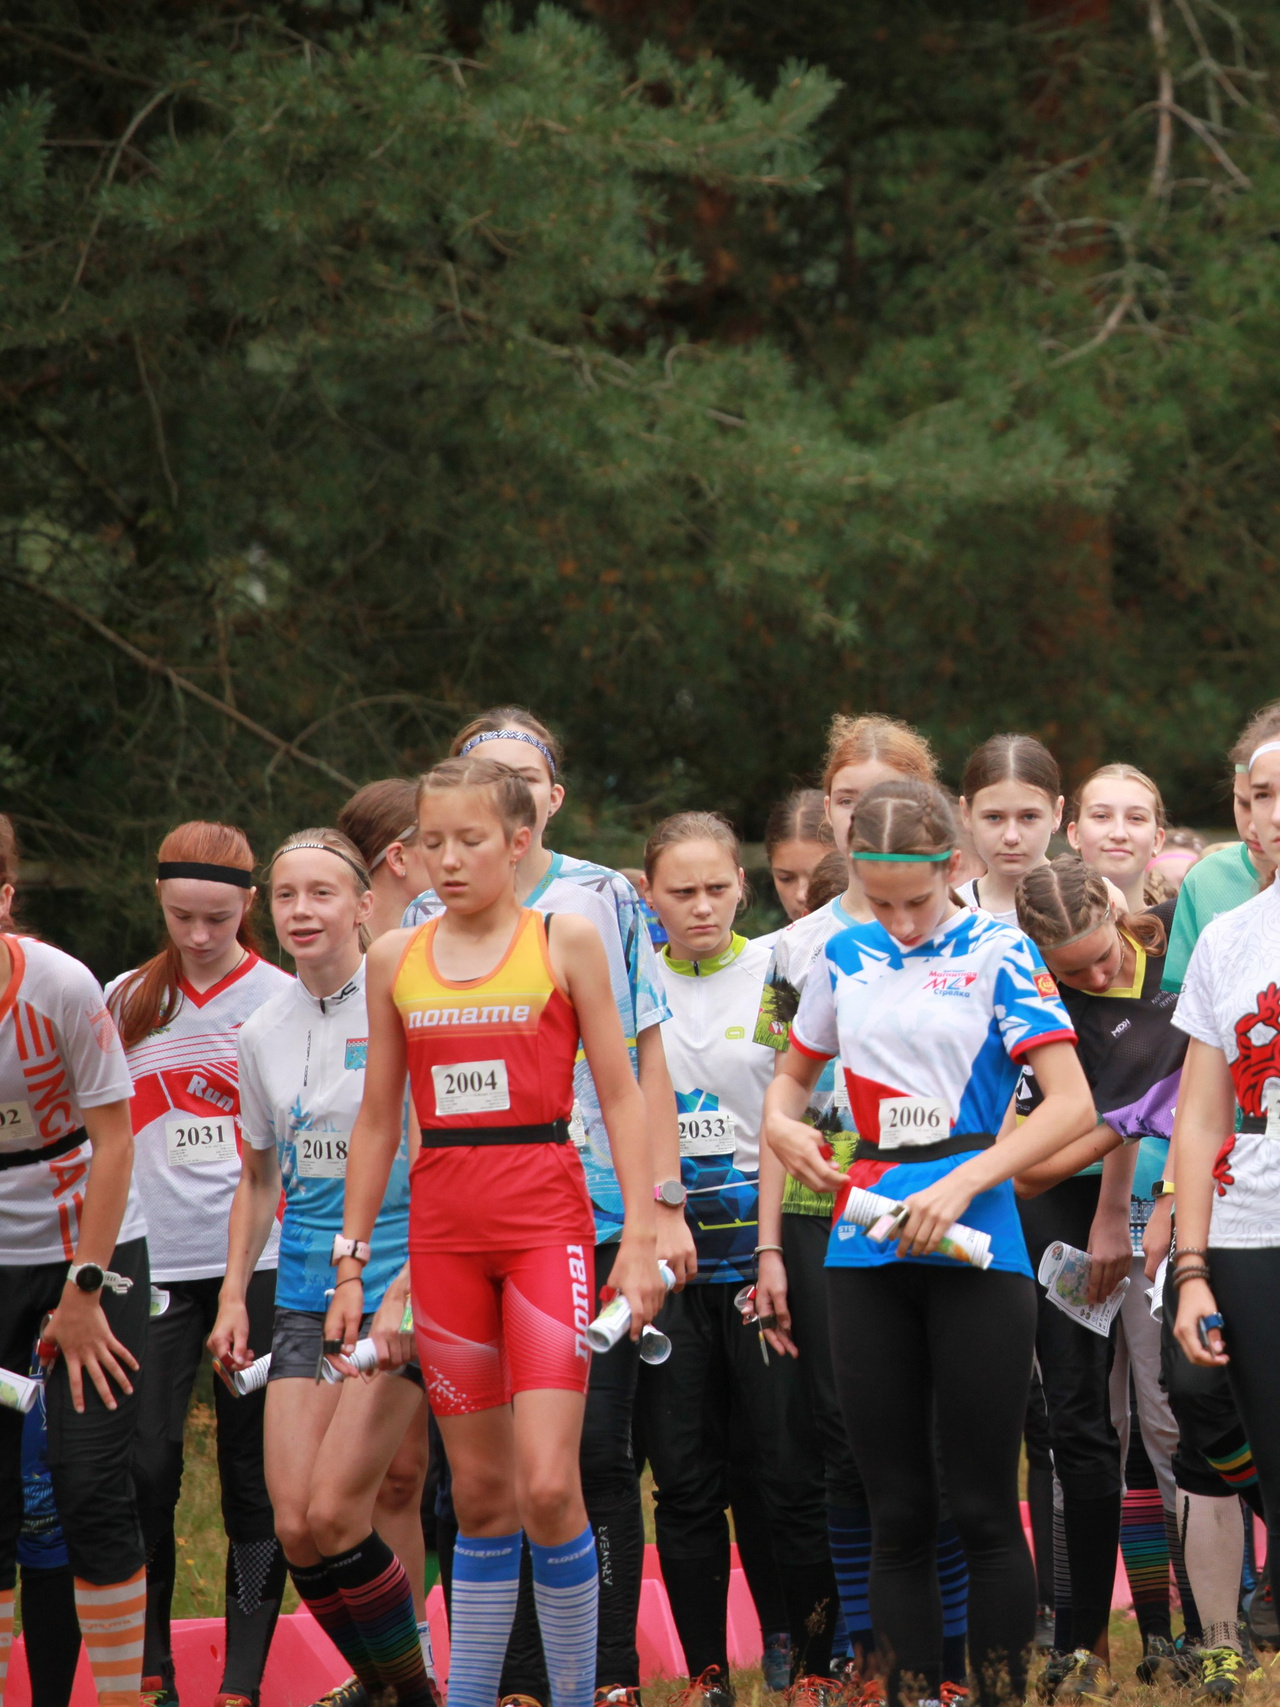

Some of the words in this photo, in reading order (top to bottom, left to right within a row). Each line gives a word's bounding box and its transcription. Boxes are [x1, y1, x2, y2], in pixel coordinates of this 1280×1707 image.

[283, 843, 325, 852] noname
[408, 1005, 530, 1029] noname
[186, 1074, 234, 1112] Run
[444, 1070, 497, 1094] 2004
[889, 1106, 940, 1128] 2006
[175, 1125, 225, 1147] 2031
[679, 1118, 726, 1139] 2033
[303, 1139, 347, 1160] 2018
[838, 1225, 856, 1233] STG
[598, 1526, 613, 1585] ARSWEAR
